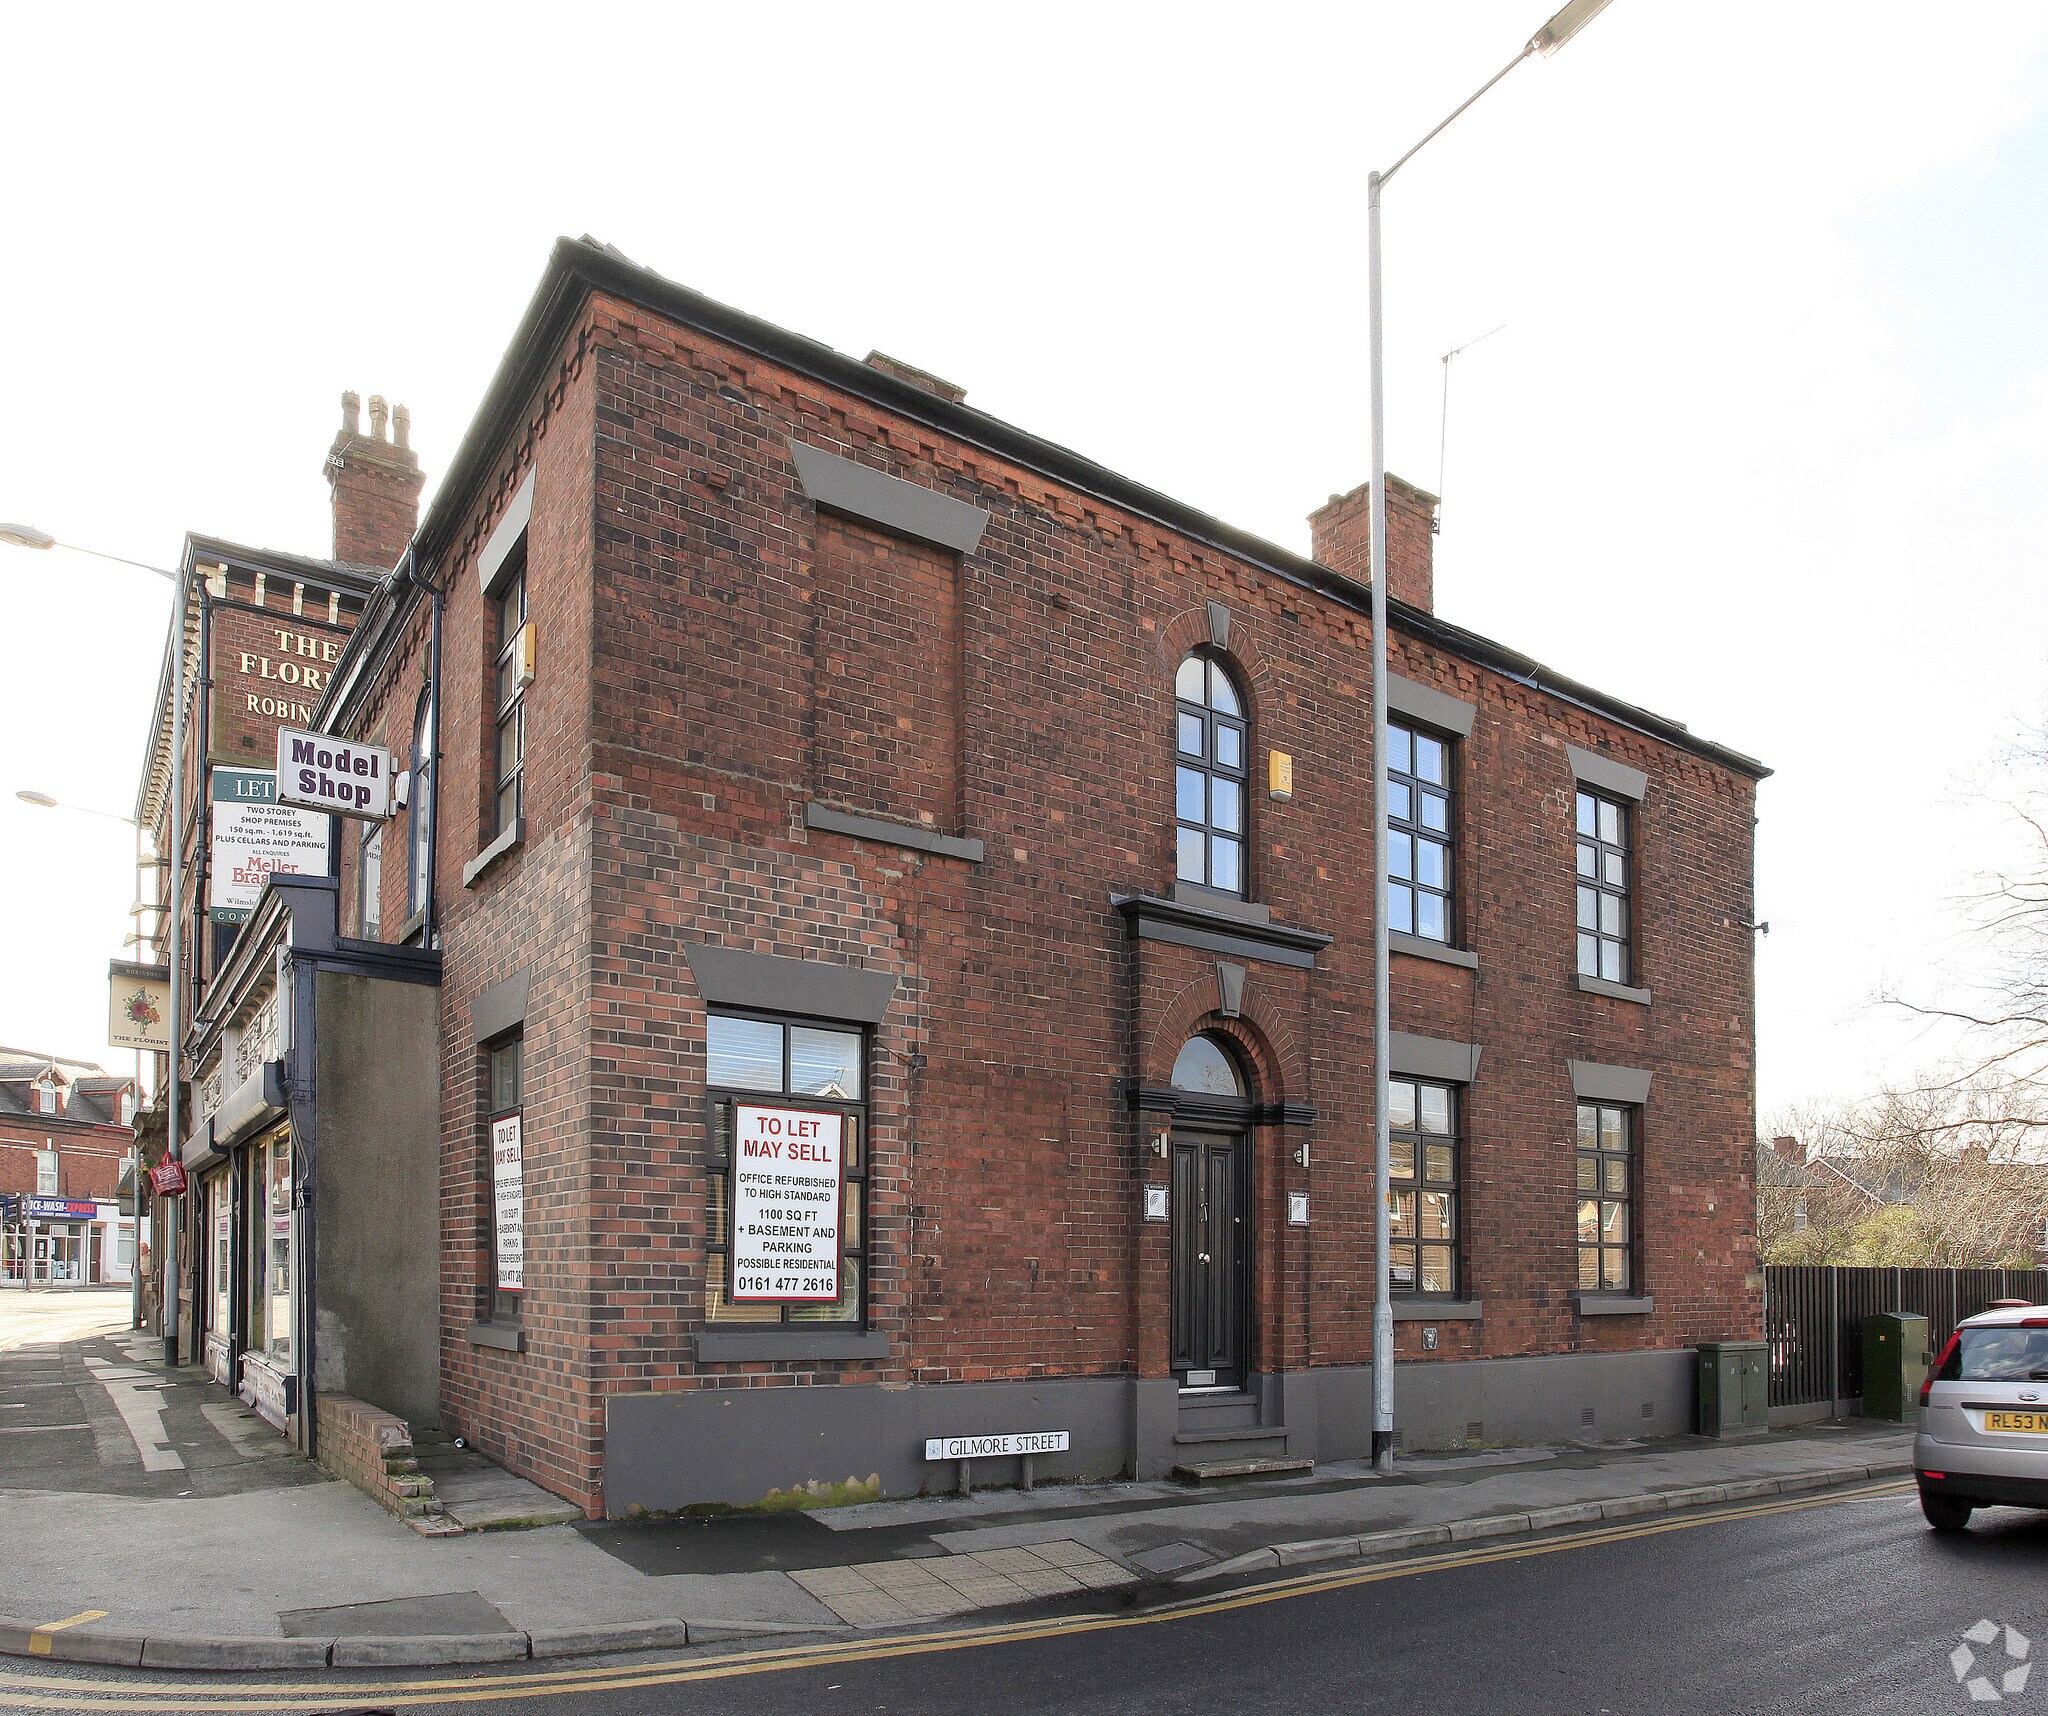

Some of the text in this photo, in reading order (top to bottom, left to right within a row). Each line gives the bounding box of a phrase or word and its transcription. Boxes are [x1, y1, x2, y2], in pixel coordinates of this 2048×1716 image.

[274, 629, 339, 664] THE
[246, 693, 311, 723] ROBIN
[292, 739, 378, 778] Model
[236, 779, 274, 797] LET
[298, 768, 371, 809] Shop
[246, 806, 297, 817] TWO STOREY
[240, 816, 302, 828] SHOP PREMISES
[229, 826, 243, 834] 150
[244, 828, 266, 836] sq.m.
[271, 829, 293, 837] 1,619
[293, 831, 314, 839] sq.ft.
[215, 834, 327, 850] PLUS CELLARS AND PARKING
[246, 856, 299, 875] Meller
[133, 1037, 169, 1045] FLORIST
[498, 1125, 516, 1144] TO LET
[757, 1116, 821, 1138] TO LET
[506, 1146, 521, 1164] SELL
[743, 1139, 832, 1162] MAY SELL
[739, 1172, 836, 1189] OFFICE REFURBISHED
[744, 1187, 831, 1202] TO HIGH STANDARD
[758, 1208, 818, 1222] 1100 SQ FT
[738, 1224, 836, 1239] + BASEMENT AND
[762, 1241, 813, 1254] PARKING
[737, 1258, 836, 1270] POSSIBLE RESIDENTIAL
[738, 1276, 834, 1292] 0161 477 2616
[1992, 1414, 2033, 1429] RL53
[949, 1434, 1063, 1456] GILMORE STREET
